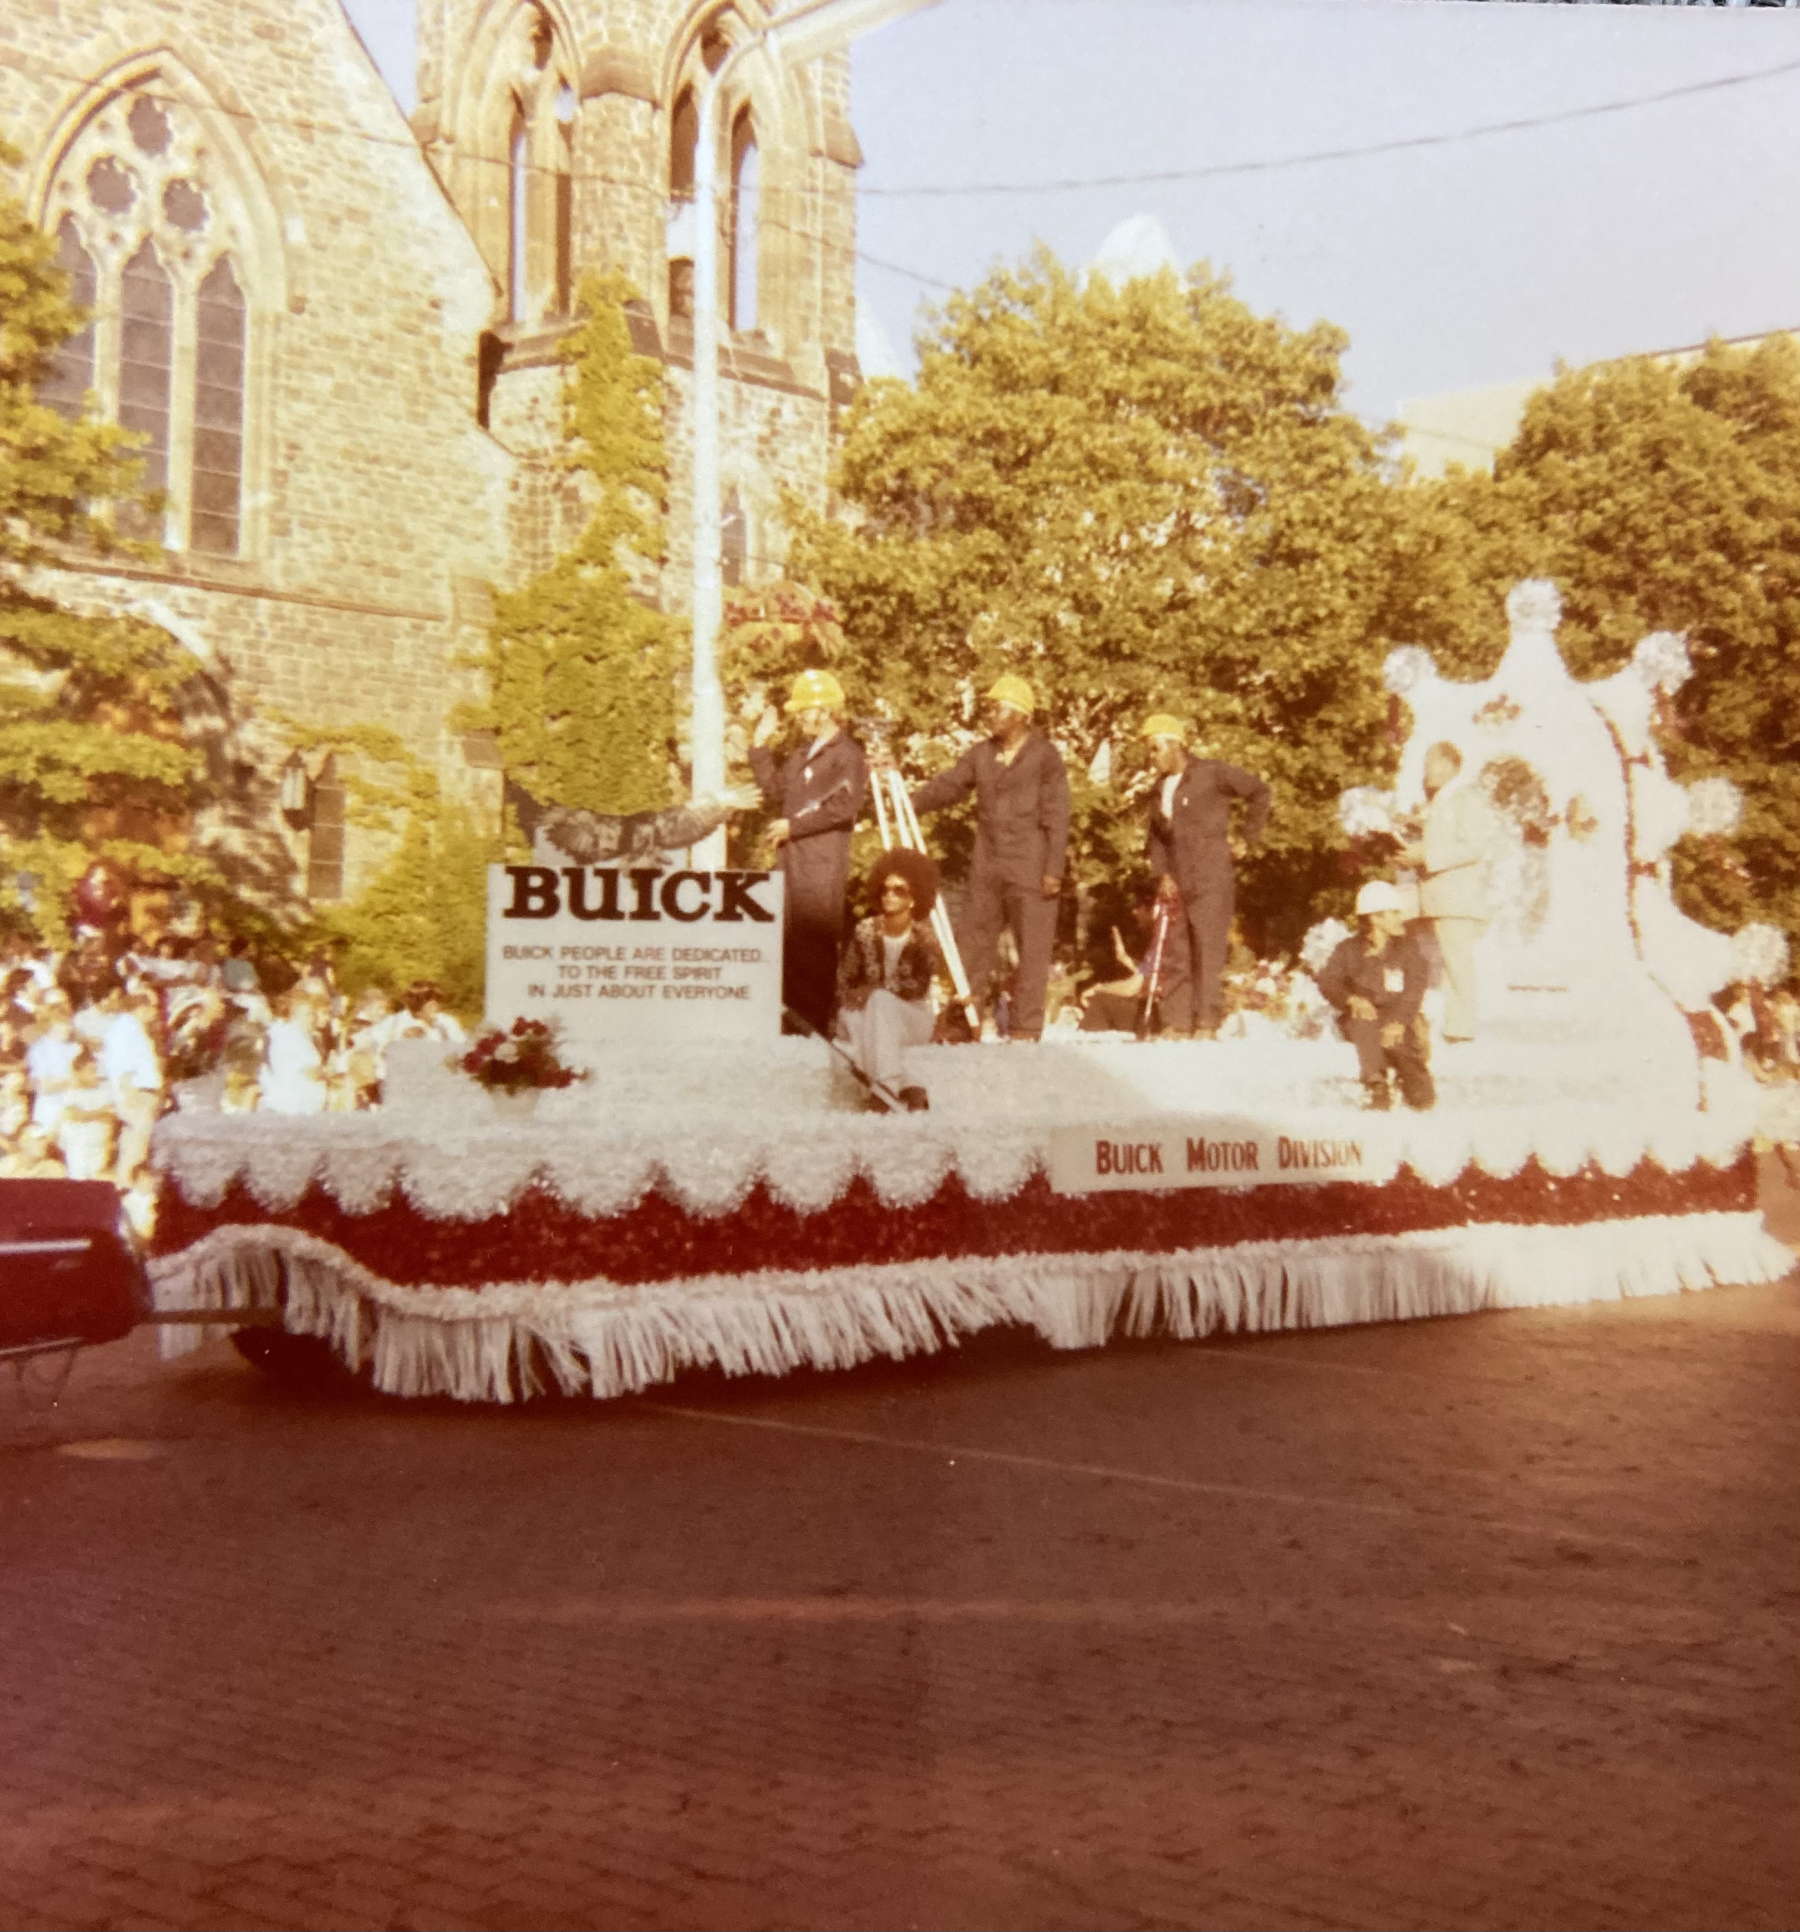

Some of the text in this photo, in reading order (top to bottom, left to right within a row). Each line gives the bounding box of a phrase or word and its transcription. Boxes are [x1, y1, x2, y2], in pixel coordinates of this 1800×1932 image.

[503, 866, 775, 922] BUICK
[503, 945, 552, 960] BUICK
[560, 946, 627, 961] PEOPLE
[632, 947, 664, 961] ARE
[557, 965, 722, 980] TO THE FREE SPIRIT
[528, 984, 750, 1000] IN JUST ABOUT EVERYONE
